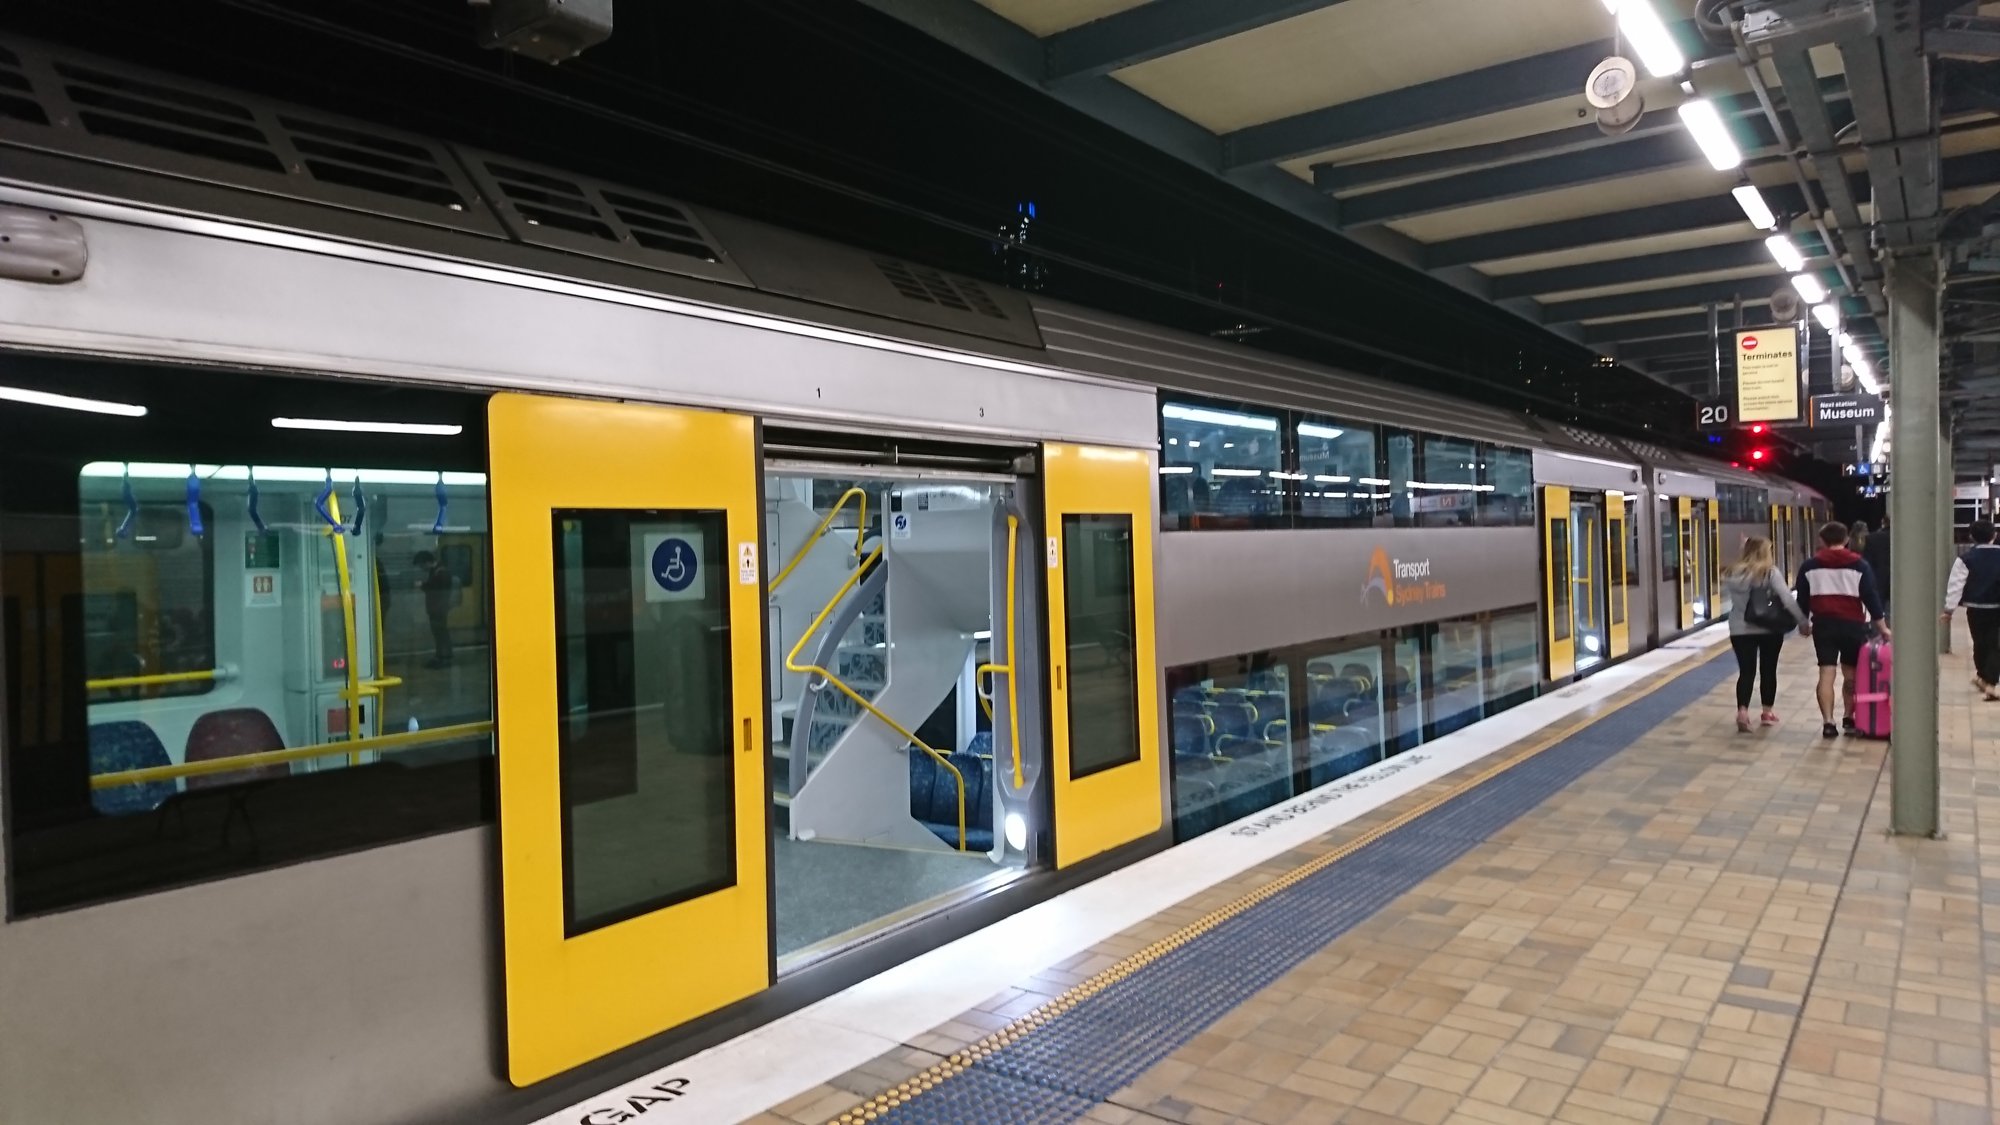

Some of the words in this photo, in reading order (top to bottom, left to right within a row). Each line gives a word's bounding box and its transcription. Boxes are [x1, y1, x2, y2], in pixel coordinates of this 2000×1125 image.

[1741, 350, 1793, 361] Terminates
[816, 387, 821, 399] 1
[979, 407, 985, 418] 3
[1700, 405, 1729, 425] 20
[1819, 406, 1875, 420] Museum
[1393, 557, 1430, 581] Transport
[580, 1078, 691, 1125] GAP
